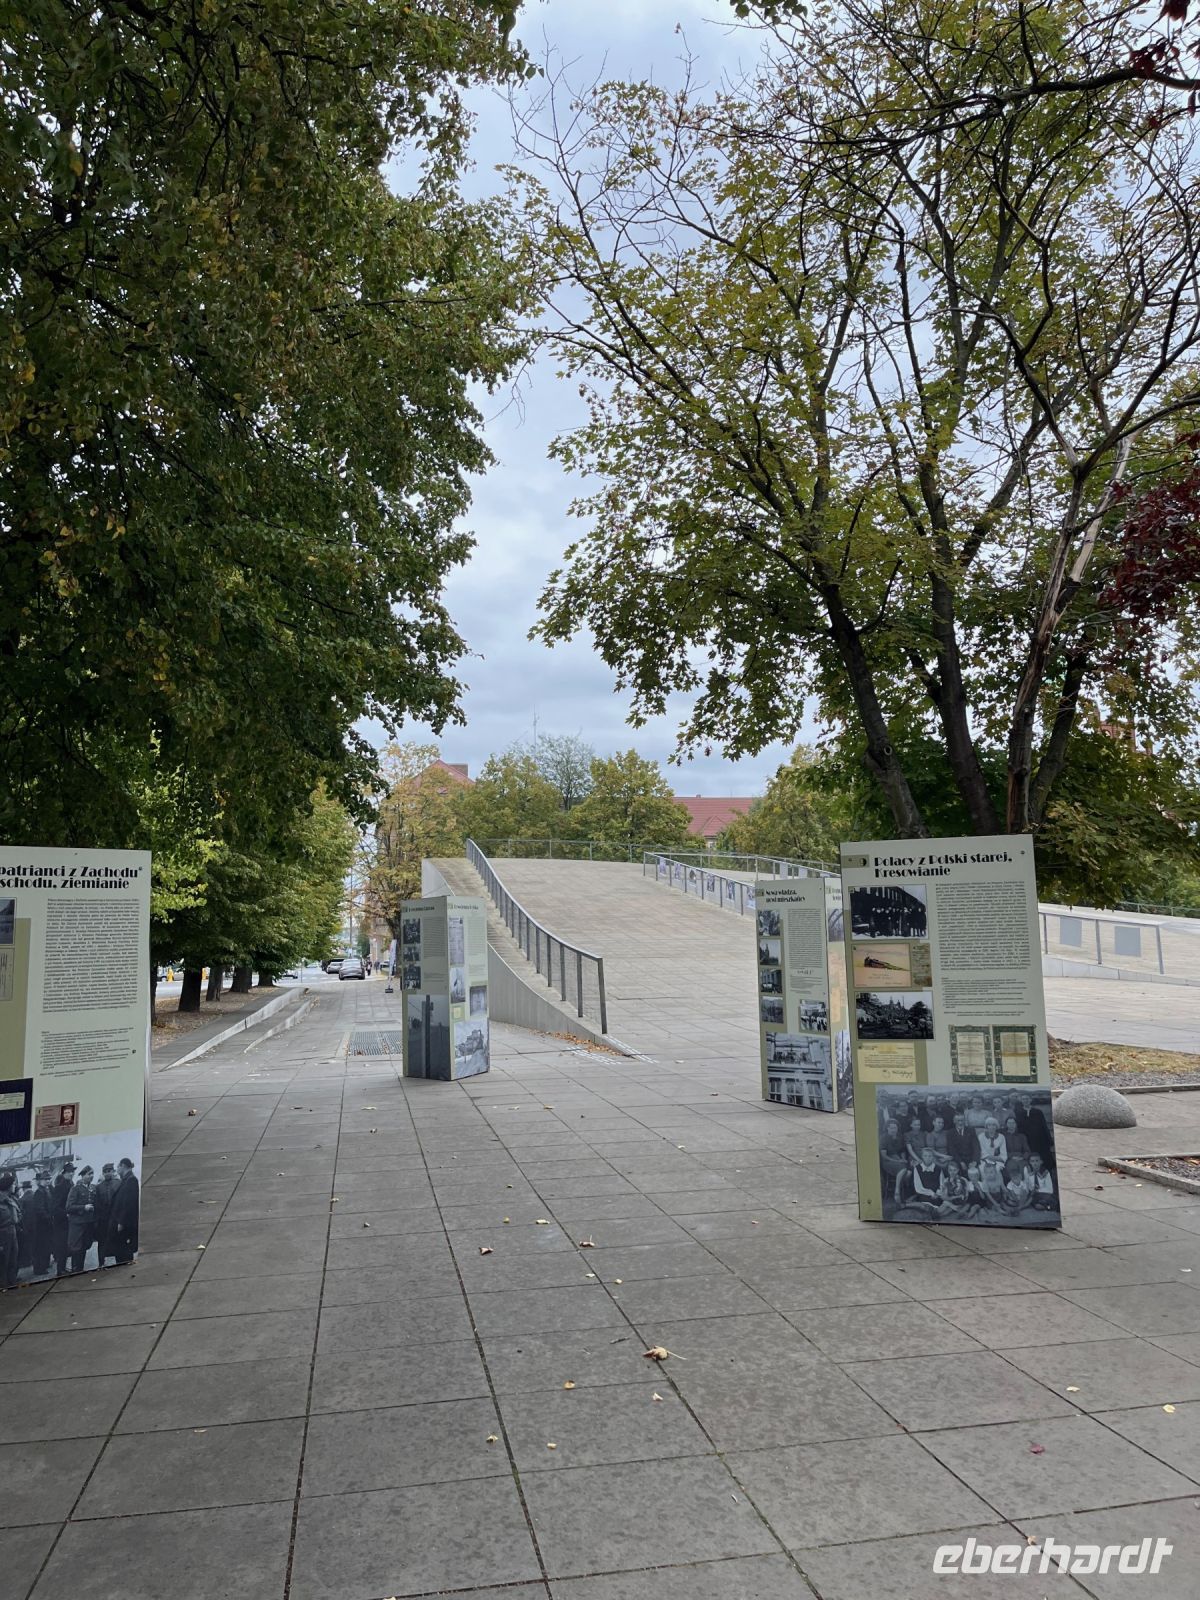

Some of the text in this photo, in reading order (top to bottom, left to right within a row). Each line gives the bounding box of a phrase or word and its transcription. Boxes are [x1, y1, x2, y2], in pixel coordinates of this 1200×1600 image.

[874, 856, 915, 867] Polacy
[918, 856, 926, 866] z
[928, 853, 968, 865] Polski
[68, 867, 78, 877] z
[874, 865, 951, 878] Kresowianie
[61, 878, 129, 889] ziemianie
